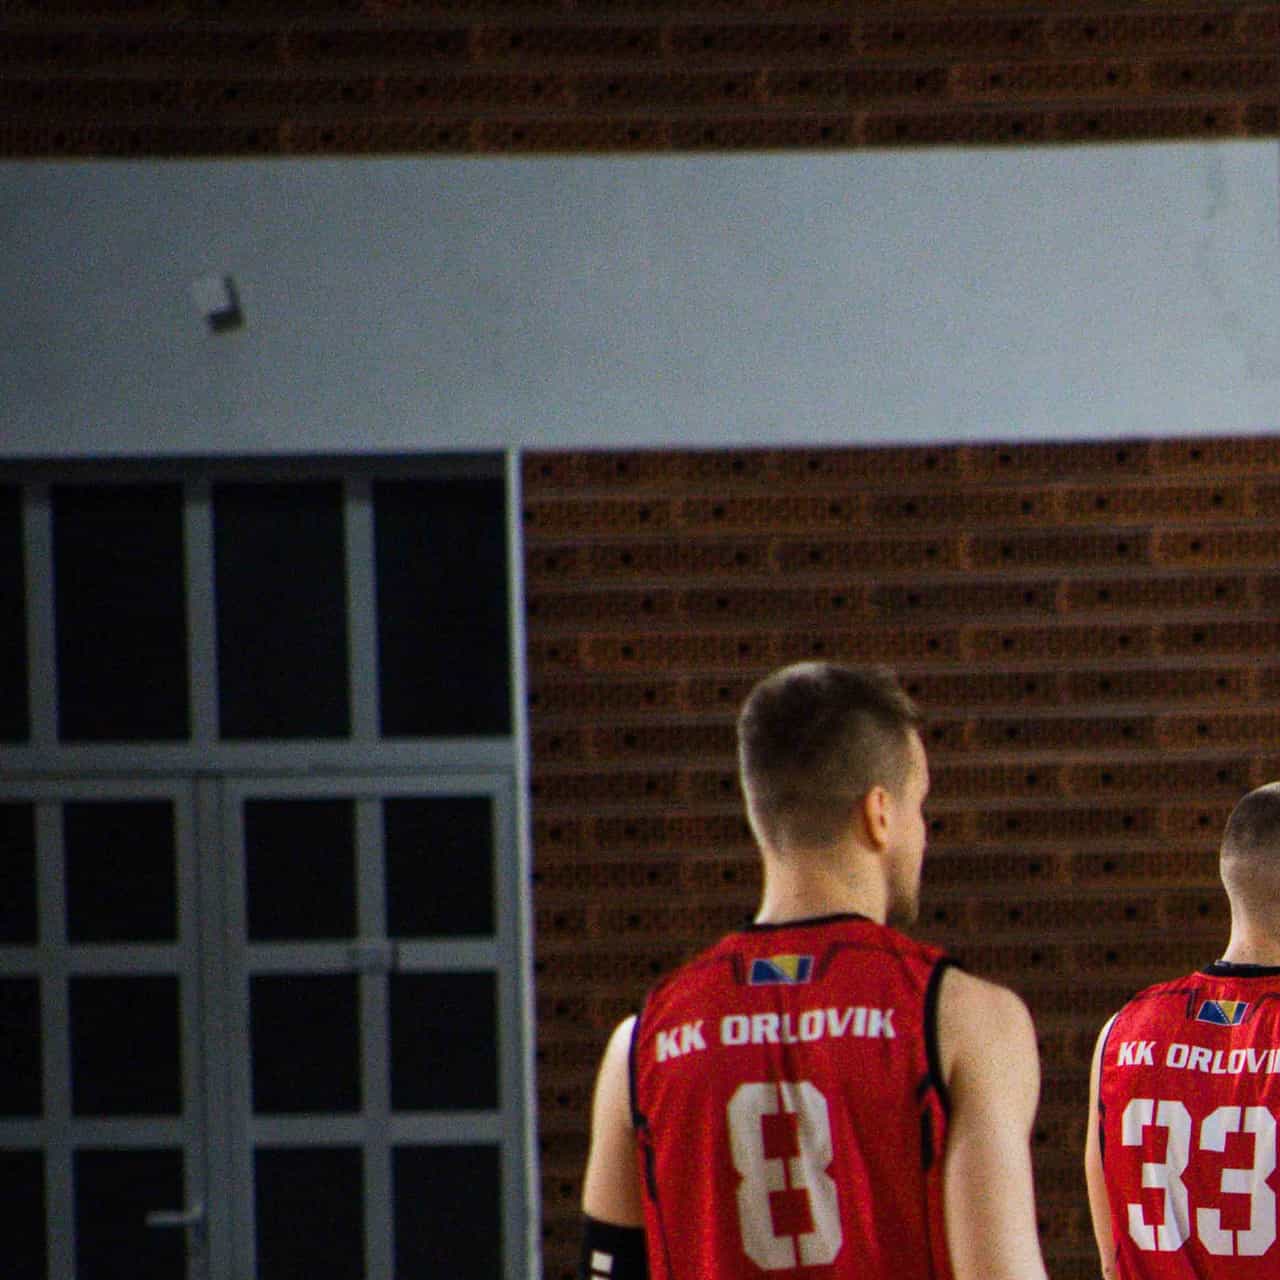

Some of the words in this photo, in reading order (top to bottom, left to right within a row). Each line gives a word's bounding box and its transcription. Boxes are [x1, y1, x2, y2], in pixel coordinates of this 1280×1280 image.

[656, 1019, 707, 1063] KK
[720, 1007, 896, 1046] ORLOVIK
[1117, 1040, 1154, 1066] KK
[727, 1081, 843, 1271] 8
[1122, 1098, 1277, 1256] 33
